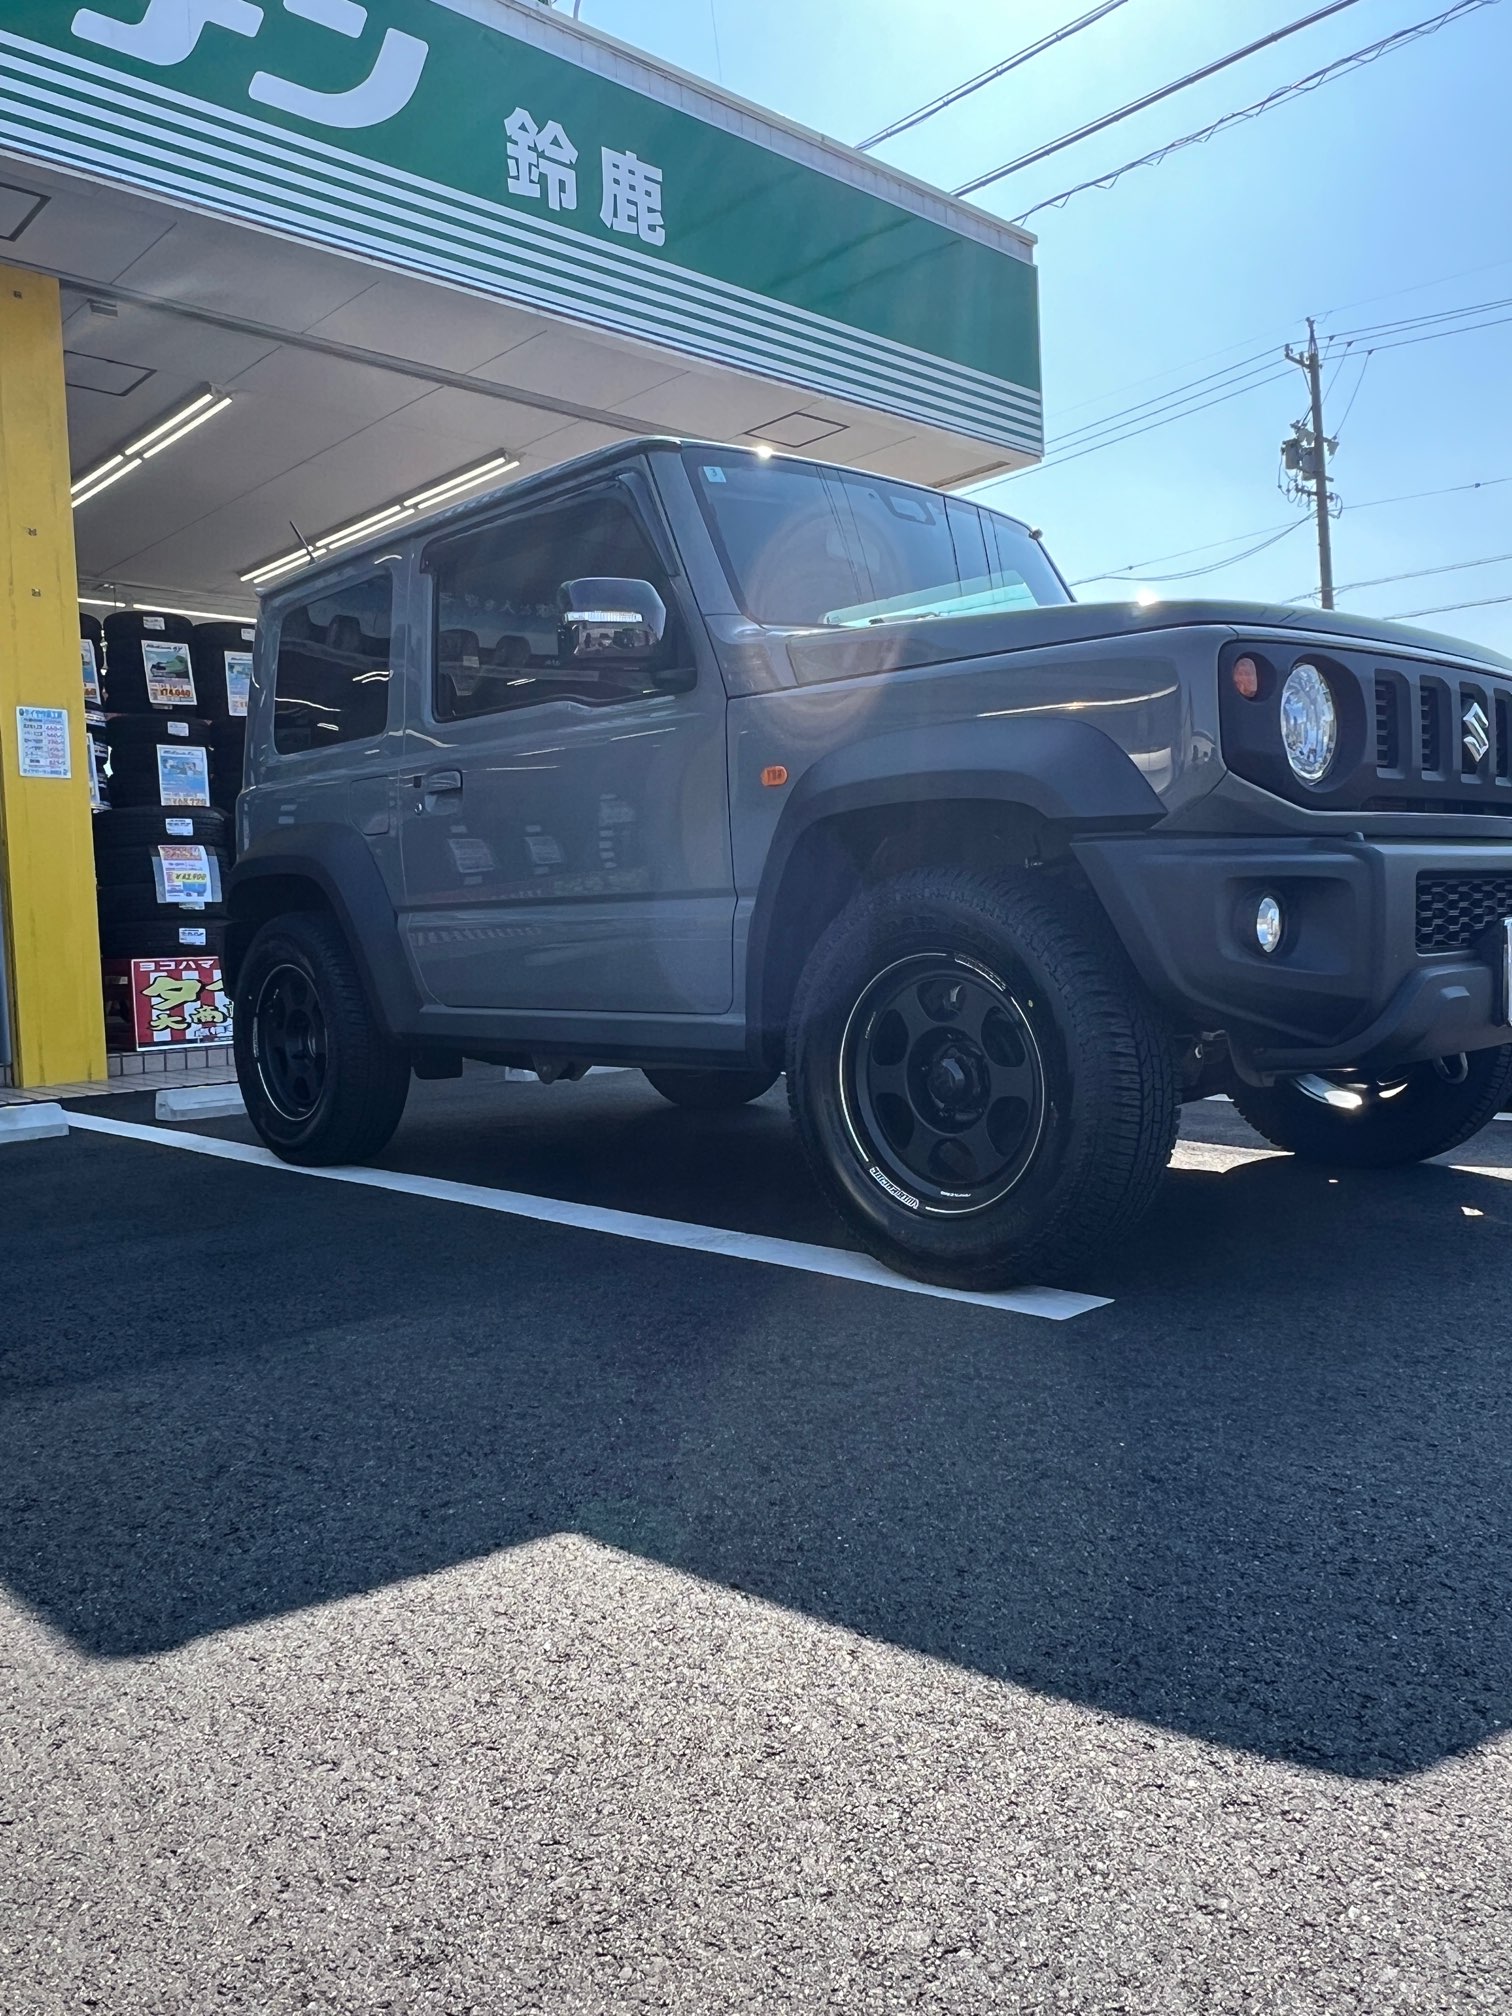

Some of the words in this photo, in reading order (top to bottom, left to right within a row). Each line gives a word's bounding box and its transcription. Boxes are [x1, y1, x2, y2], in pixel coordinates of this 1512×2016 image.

[503, 107, 666, 247] 鈴鹿
[139, 960, 214, 971] ヨコハマ
[141, 976, 224, 1011] タ
[150, 1001, 233, 1031] 大商
